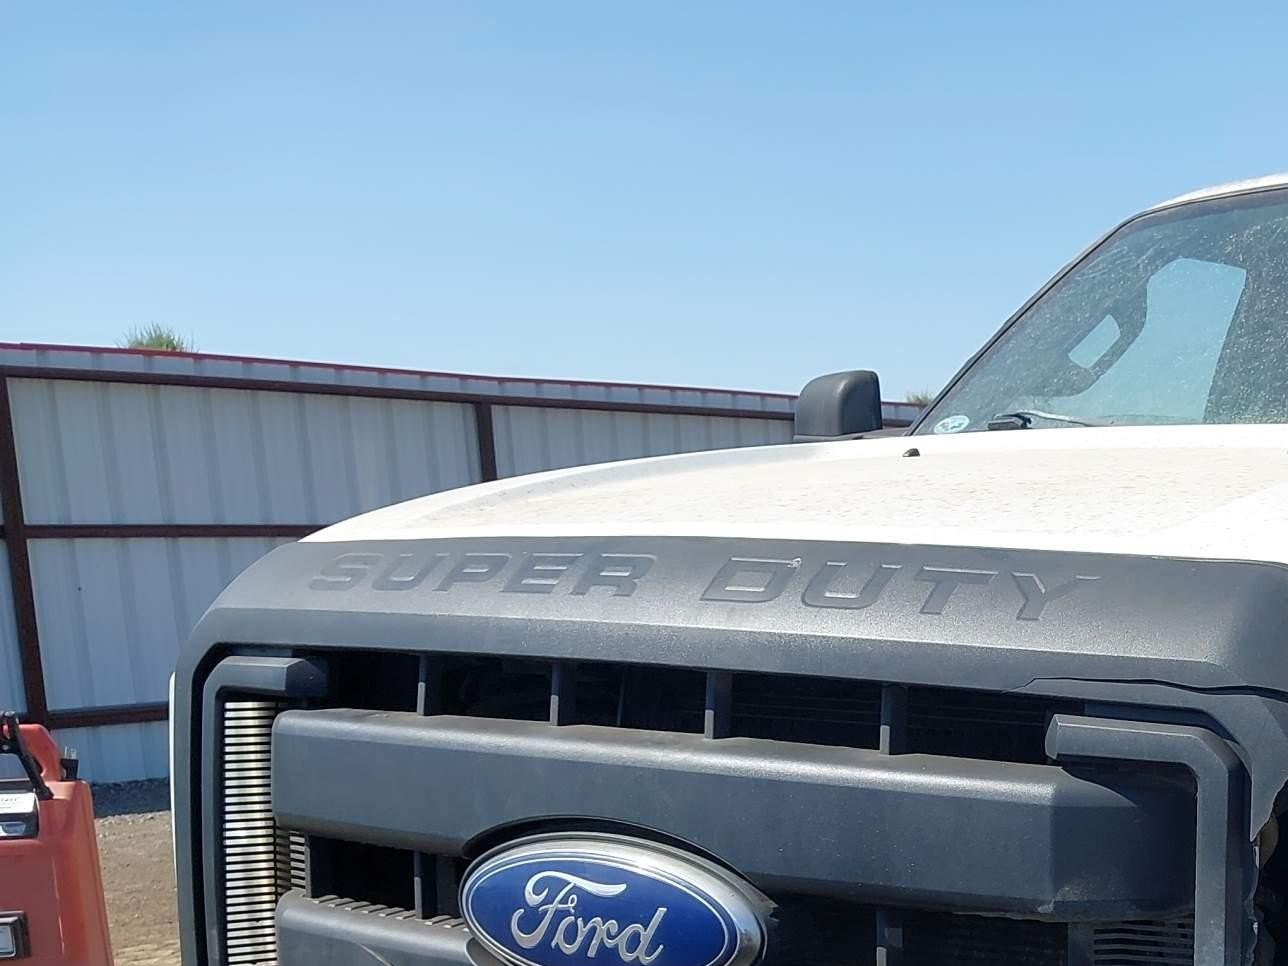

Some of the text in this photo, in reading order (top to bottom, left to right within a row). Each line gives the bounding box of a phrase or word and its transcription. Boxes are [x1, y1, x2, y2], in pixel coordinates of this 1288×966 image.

[308, 552, 1101, 621] SUPER DUTY
[511, 870, 668, 966] Ford
